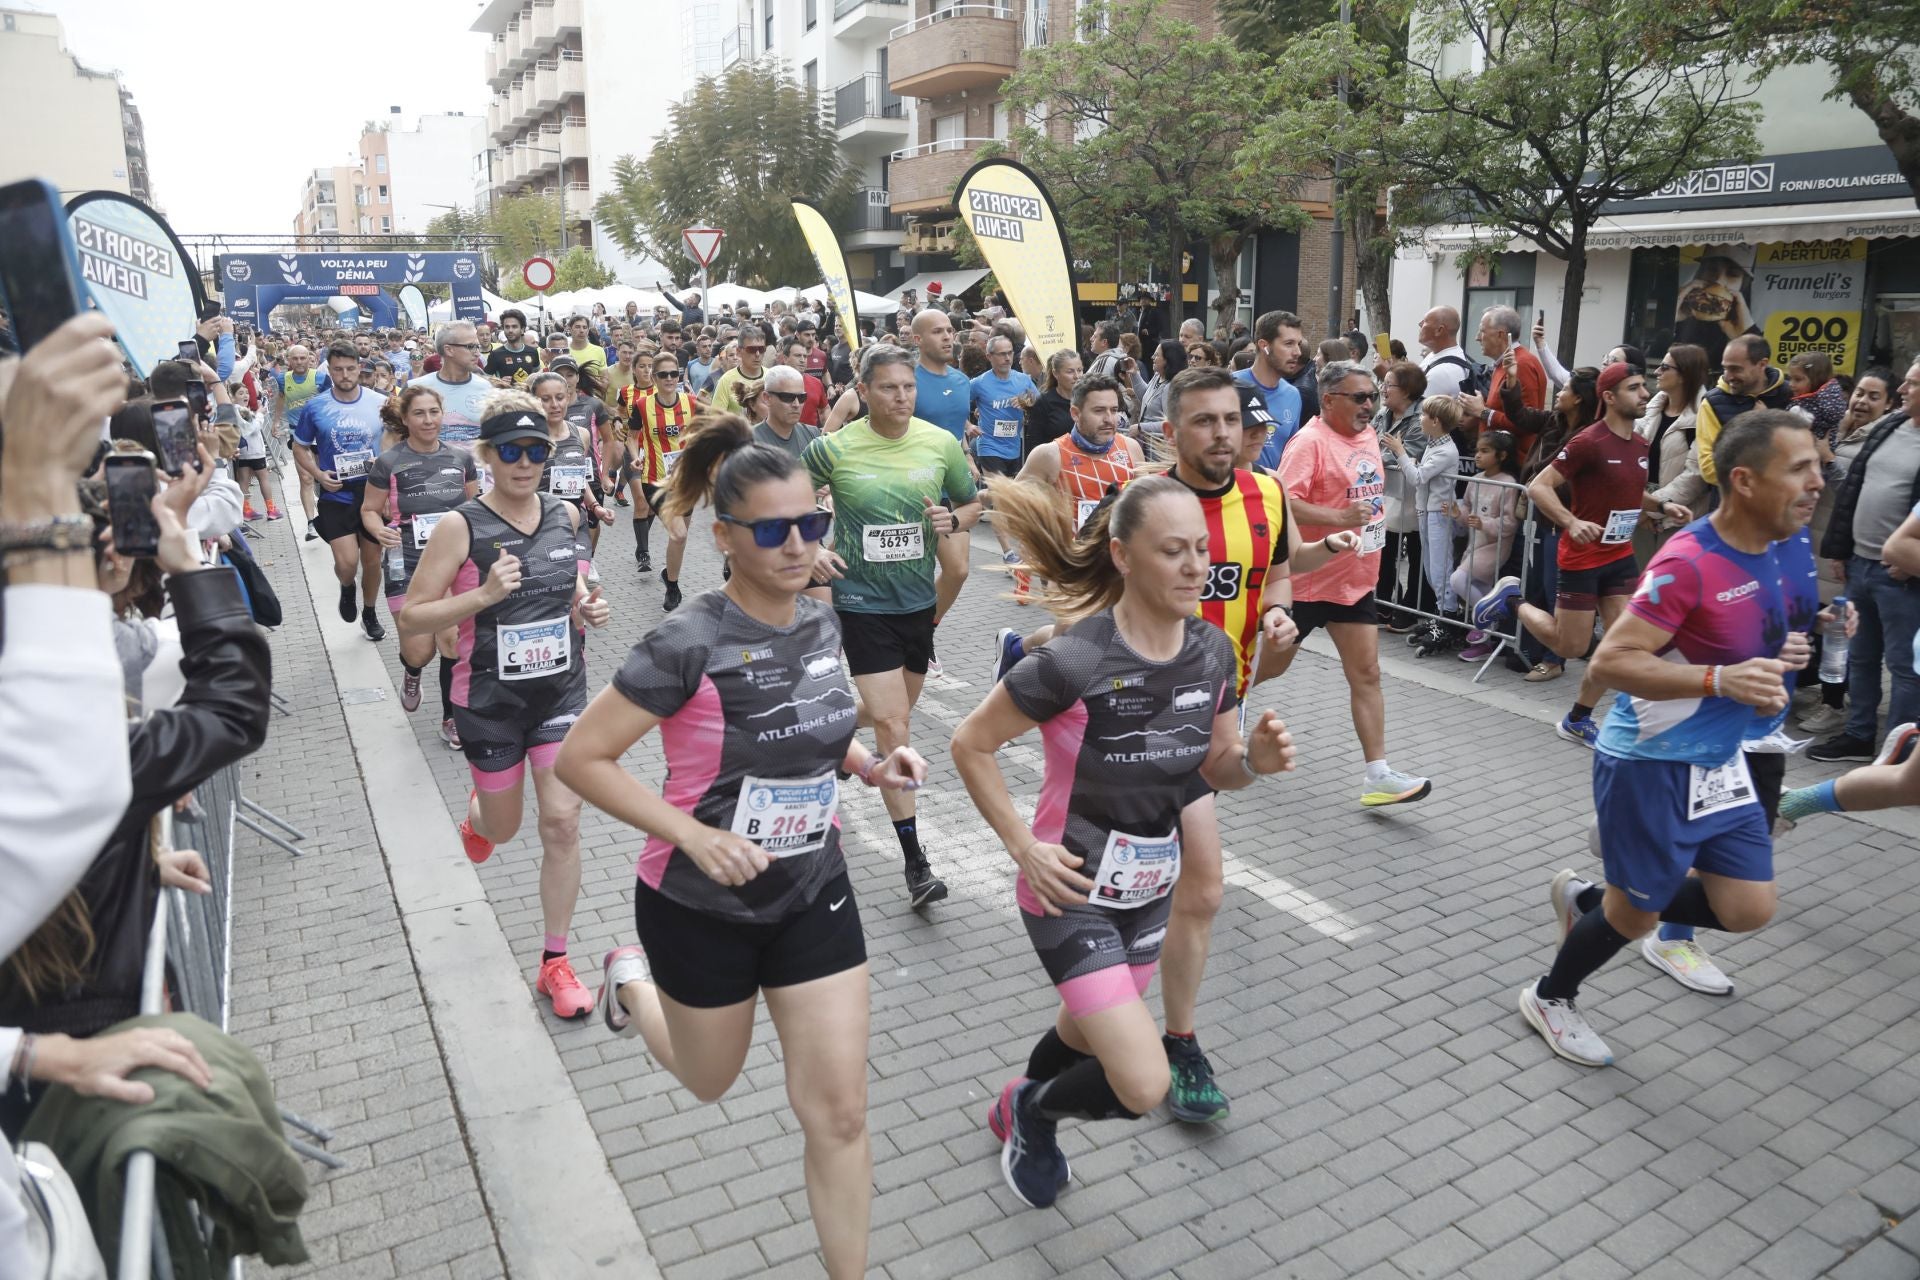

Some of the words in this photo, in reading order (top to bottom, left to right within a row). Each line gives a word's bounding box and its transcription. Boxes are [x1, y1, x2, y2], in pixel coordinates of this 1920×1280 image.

[1846, 224, 1909, 236] PuraMasa
[1769, 248, 1851, 261] APERTURA
[320, 260, 355, 268] VOLTA
[357, 260, 365, 268] A
[366, 260, 388, 268] PEU
[336, 269, 375, 280] DÉNIA
[1765, 272, 1853, 291] Fanneli's
[1812, 289, 1851, 300] burgers
[1780, 317, 1849, 342] 200
[1778, 342, 1846, 353] BURGERS
[419, 530, 426, 539] C
[898, 527, 918, 535] ESPORT
[880, 535, 909, 549] 3629
[507, 652, 517, 664] C
[524, 646, 552, 663] 316
[520, 659, 557, 672] BALEARIA
[757, 716, 826, 742] ATLETISME
[1104, 749, 1174, 763] ATLETISME
[747, 818, 761, 835] B
[771, 814, 808, 836] 216
[760, 835, 809, 848] BALEARIA
[1110, 871, 1123, 886] C
[1130, 869, 1162, 889] 228
